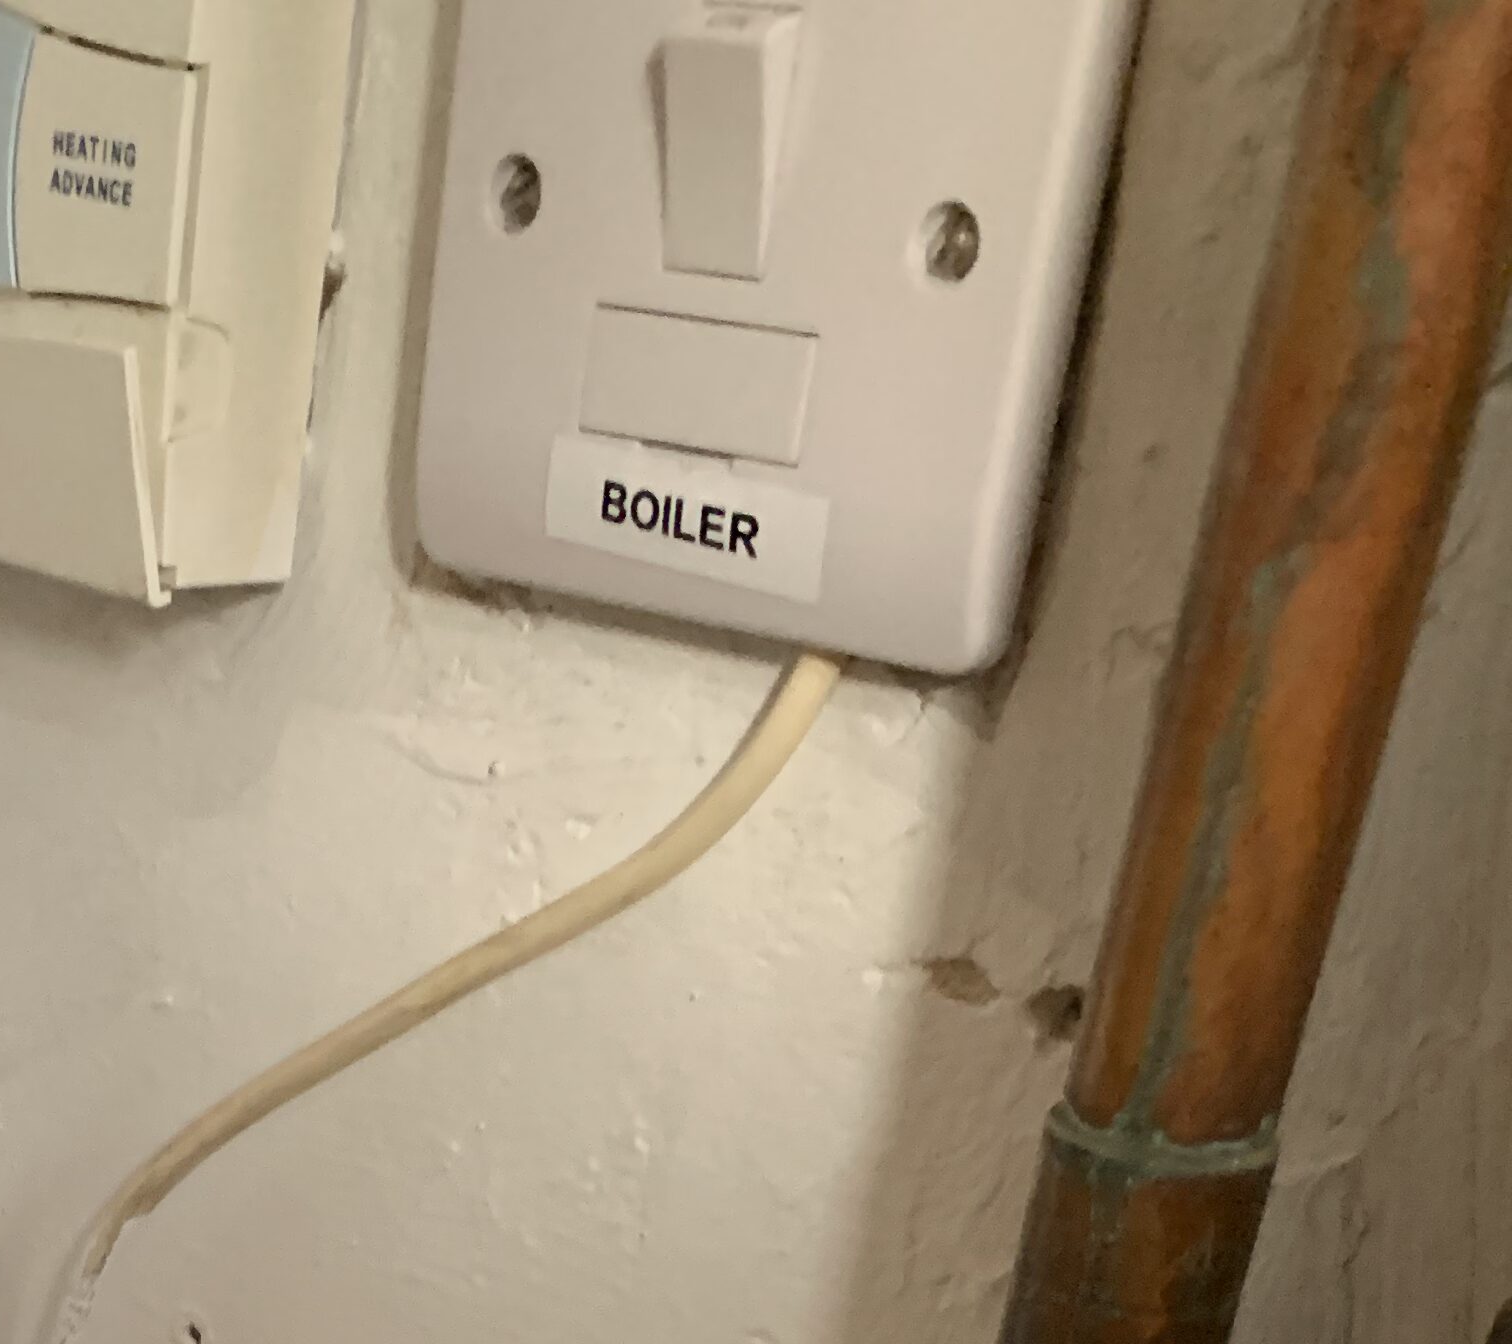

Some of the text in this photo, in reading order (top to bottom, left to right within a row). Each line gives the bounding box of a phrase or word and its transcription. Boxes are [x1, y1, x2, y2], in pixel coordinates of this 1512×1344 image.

[52, 131, 137, 168] HEATING
[49, 168, 133, 207] ADVANCE
[600, 479, 760, 560] BOILER
